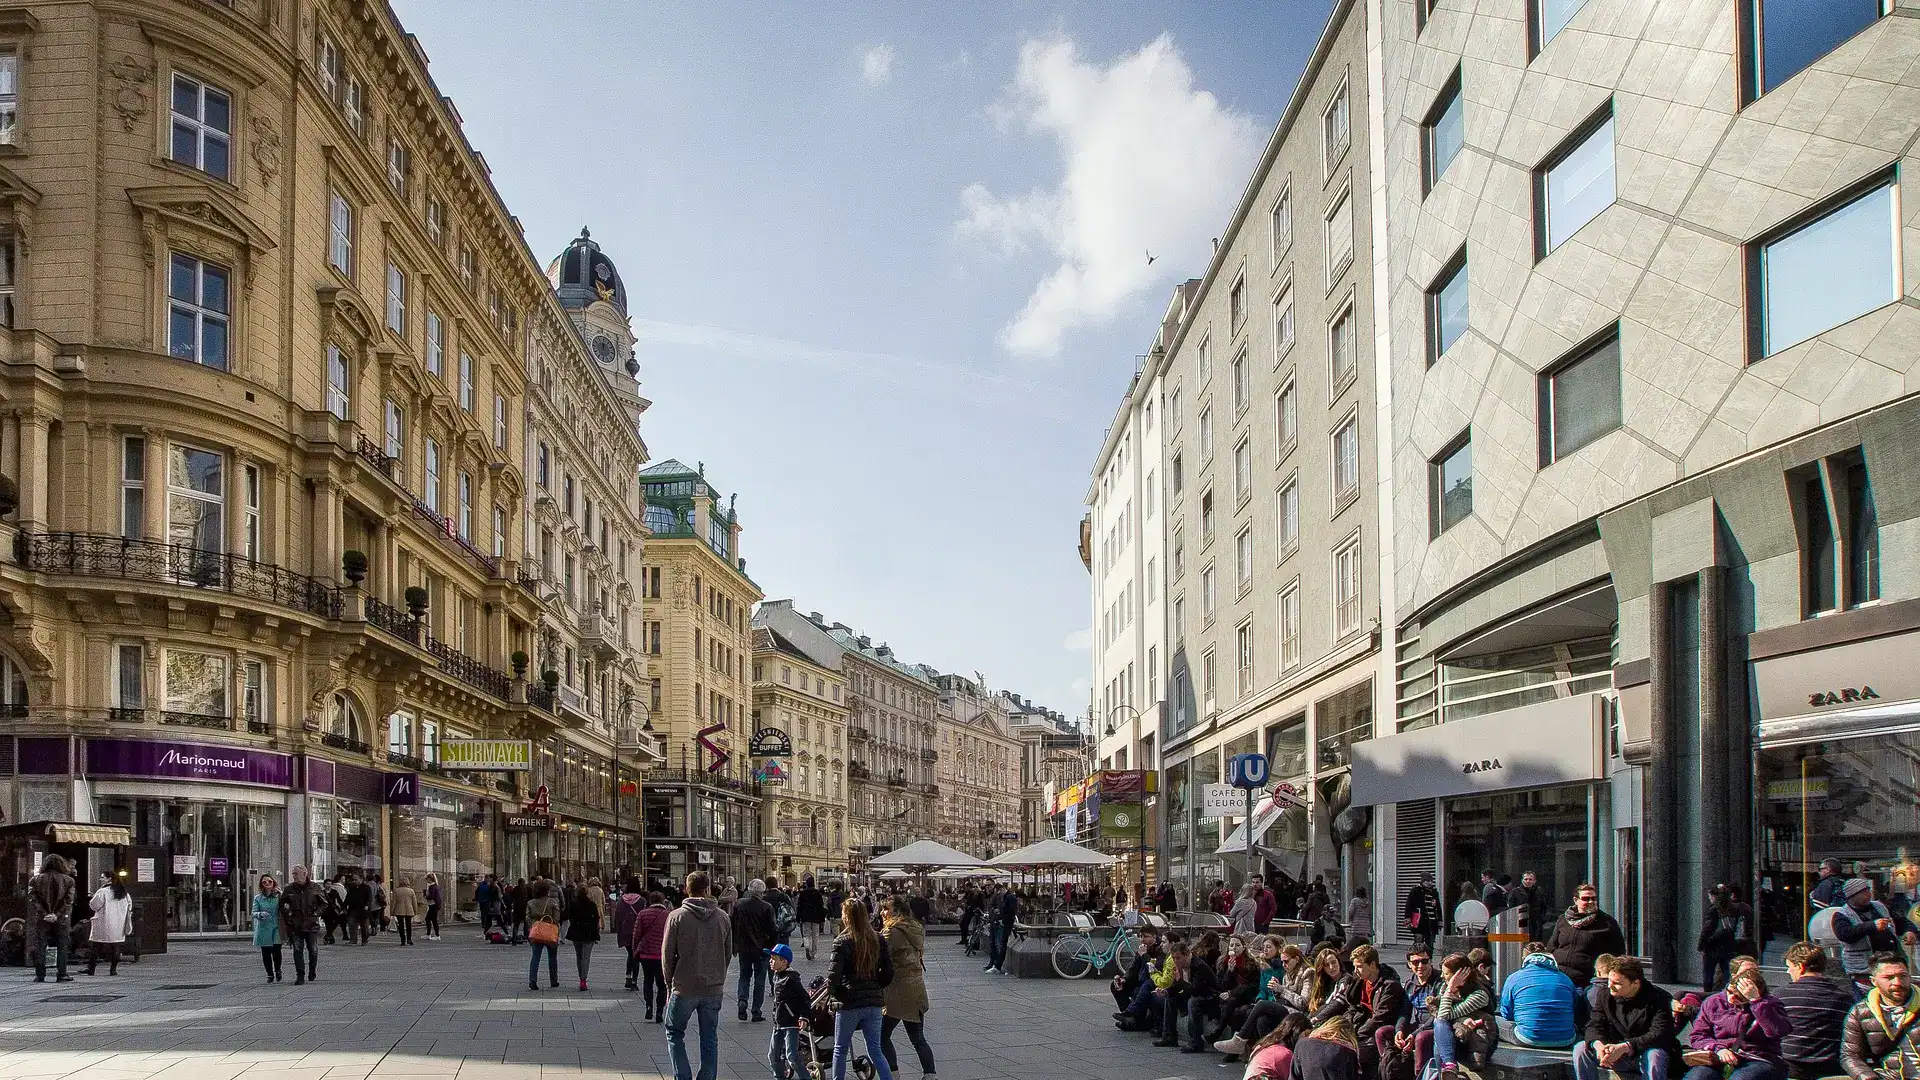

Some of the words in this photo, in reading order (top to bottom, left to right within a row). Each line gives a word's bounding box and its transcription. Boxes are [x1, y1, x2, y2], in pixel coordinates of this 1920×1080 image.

[1808, 685, 1880, 707] ZARA
[159, 749, 245, 768] Marionnaud
[447, 741, 523, 762] STURMAYR
[1230, 760, 1237, 782] U
[1244, 760, 1264, 782] U
[1462, 758, 1503, 774] ZARA
[389, 777, 411, 798] M
[1207, 799, 1257, 807] L'EUROE
[510, 817, 547, 827] APOTHEKE
